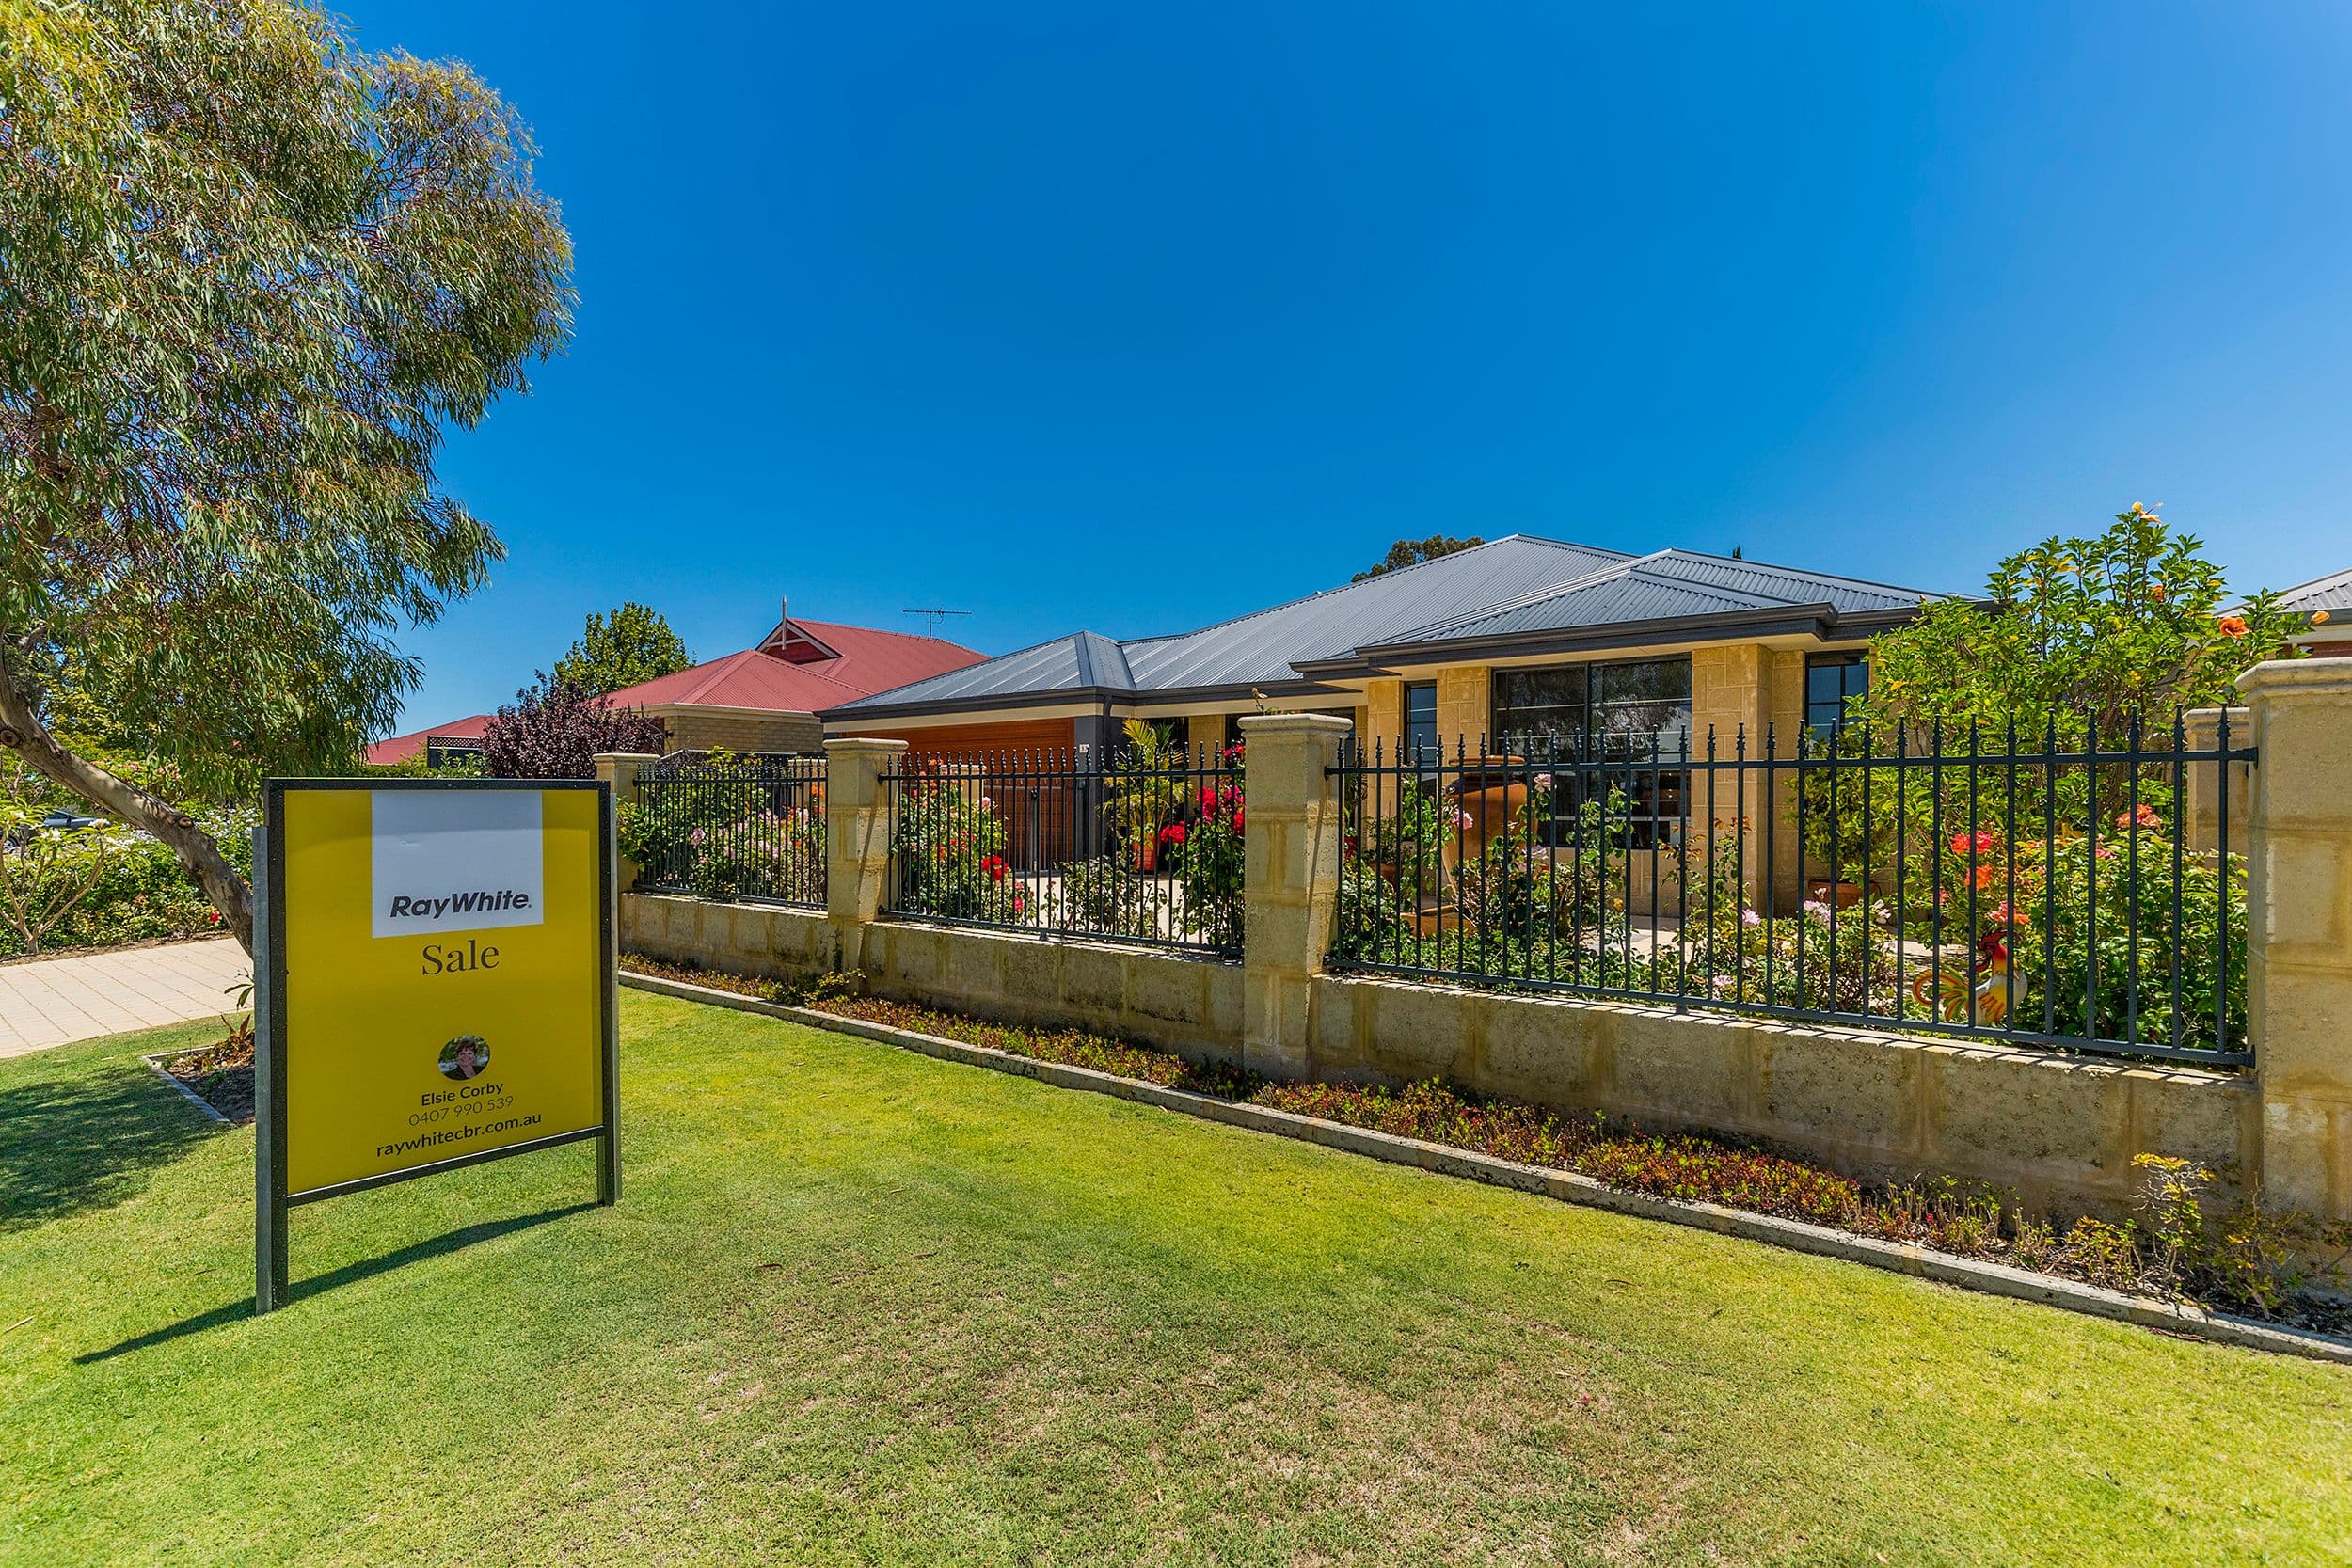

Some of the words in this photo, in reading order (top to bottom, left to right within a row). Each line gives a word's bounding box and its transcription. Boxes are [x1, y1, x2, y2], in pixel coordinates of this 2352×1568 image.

[421, 939, 500, 976] Sale
[408, 1107, 450, 1127] 0407
[453, 1101, 483, 1118] 990
[486, 1095, 515, 1112] 539
[421, 1090, 456, 1107] Elsie
[460, 1083, 504, 1100] Corby
[376, 1113, 542, 1157] raywhitecbr.com.au
